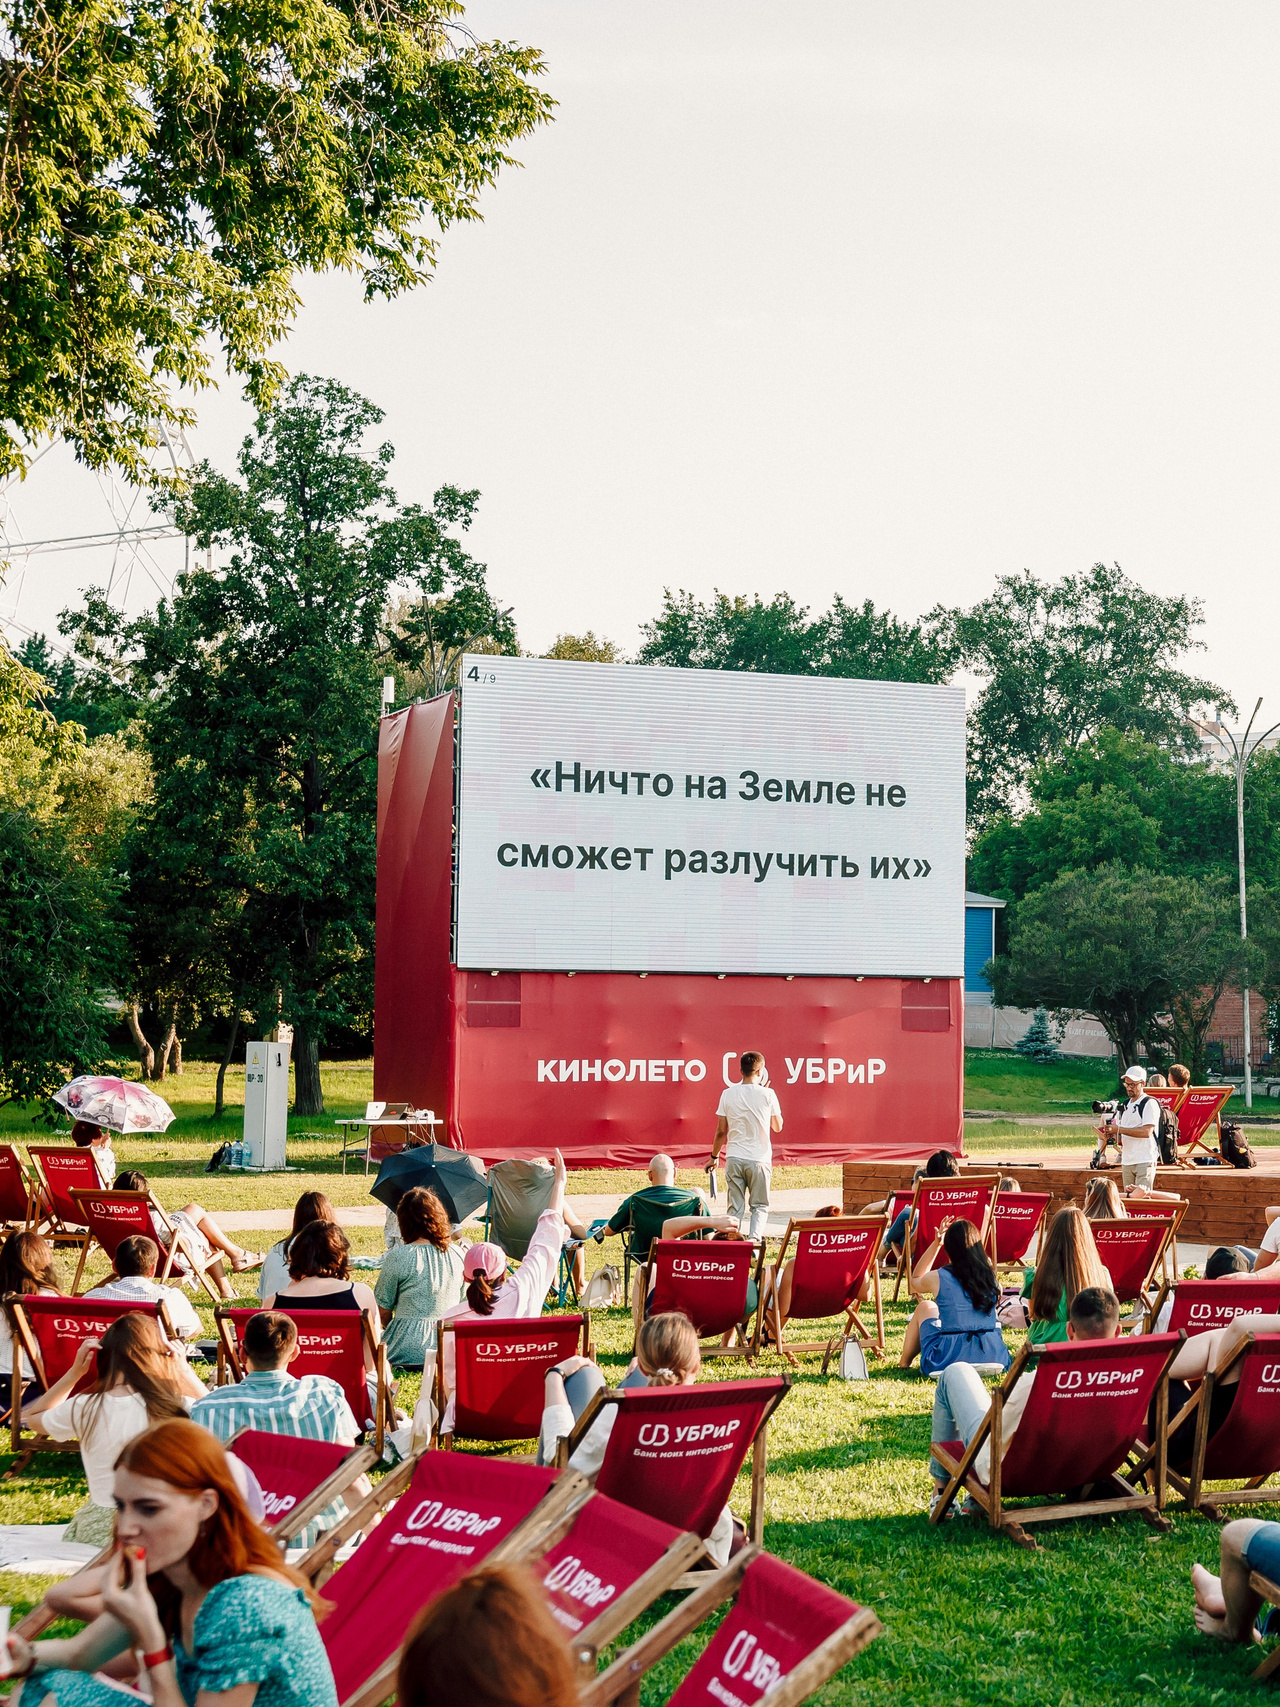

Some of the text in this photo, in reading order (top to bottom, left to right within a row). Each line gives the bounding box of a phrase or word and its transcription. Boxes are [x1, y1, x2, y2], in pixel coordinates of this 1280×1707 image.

[529, 760, 908, 808] «Ничто на Земле не
[496, 841, 932, 883] сможет разлучить их»
[537, 1058, 707, 1083] КИНОЛЕТО
[784, 1056, 887, 1084] УБРиР
[946, 1190, 979, 1200] УБРиР
[105, 1204, 140, 1215] УБРиР
[1006, 1206, 1034, 1216] УБРиР
[830, 1232, 869, 1245] УБРиР
[1114, 1230, 1150, 1239] УБРиР
[694, 1261, 736, 1273] УБРиР
[297, 1335, 343, 1347] БРиР
[504, 1341, 559, 1355] УБРиР
[517, 1353, 558, 1363] интересов
[1086, 1368, 1145, 1386] УБРиР
[1051, 1390, 1072, 1399] Банк
[1096, 1387, 1139, 1398] интересов
[1257, 1385, 1275, 1393] Банк
[674, 1419, 741, 1443] УБРиР
[633, 1441, 735, 1459] Банк моих интересов
[432, 1507, 502, 1537] УБРиР
[564, 1568, 616, 1608] УБРиР
